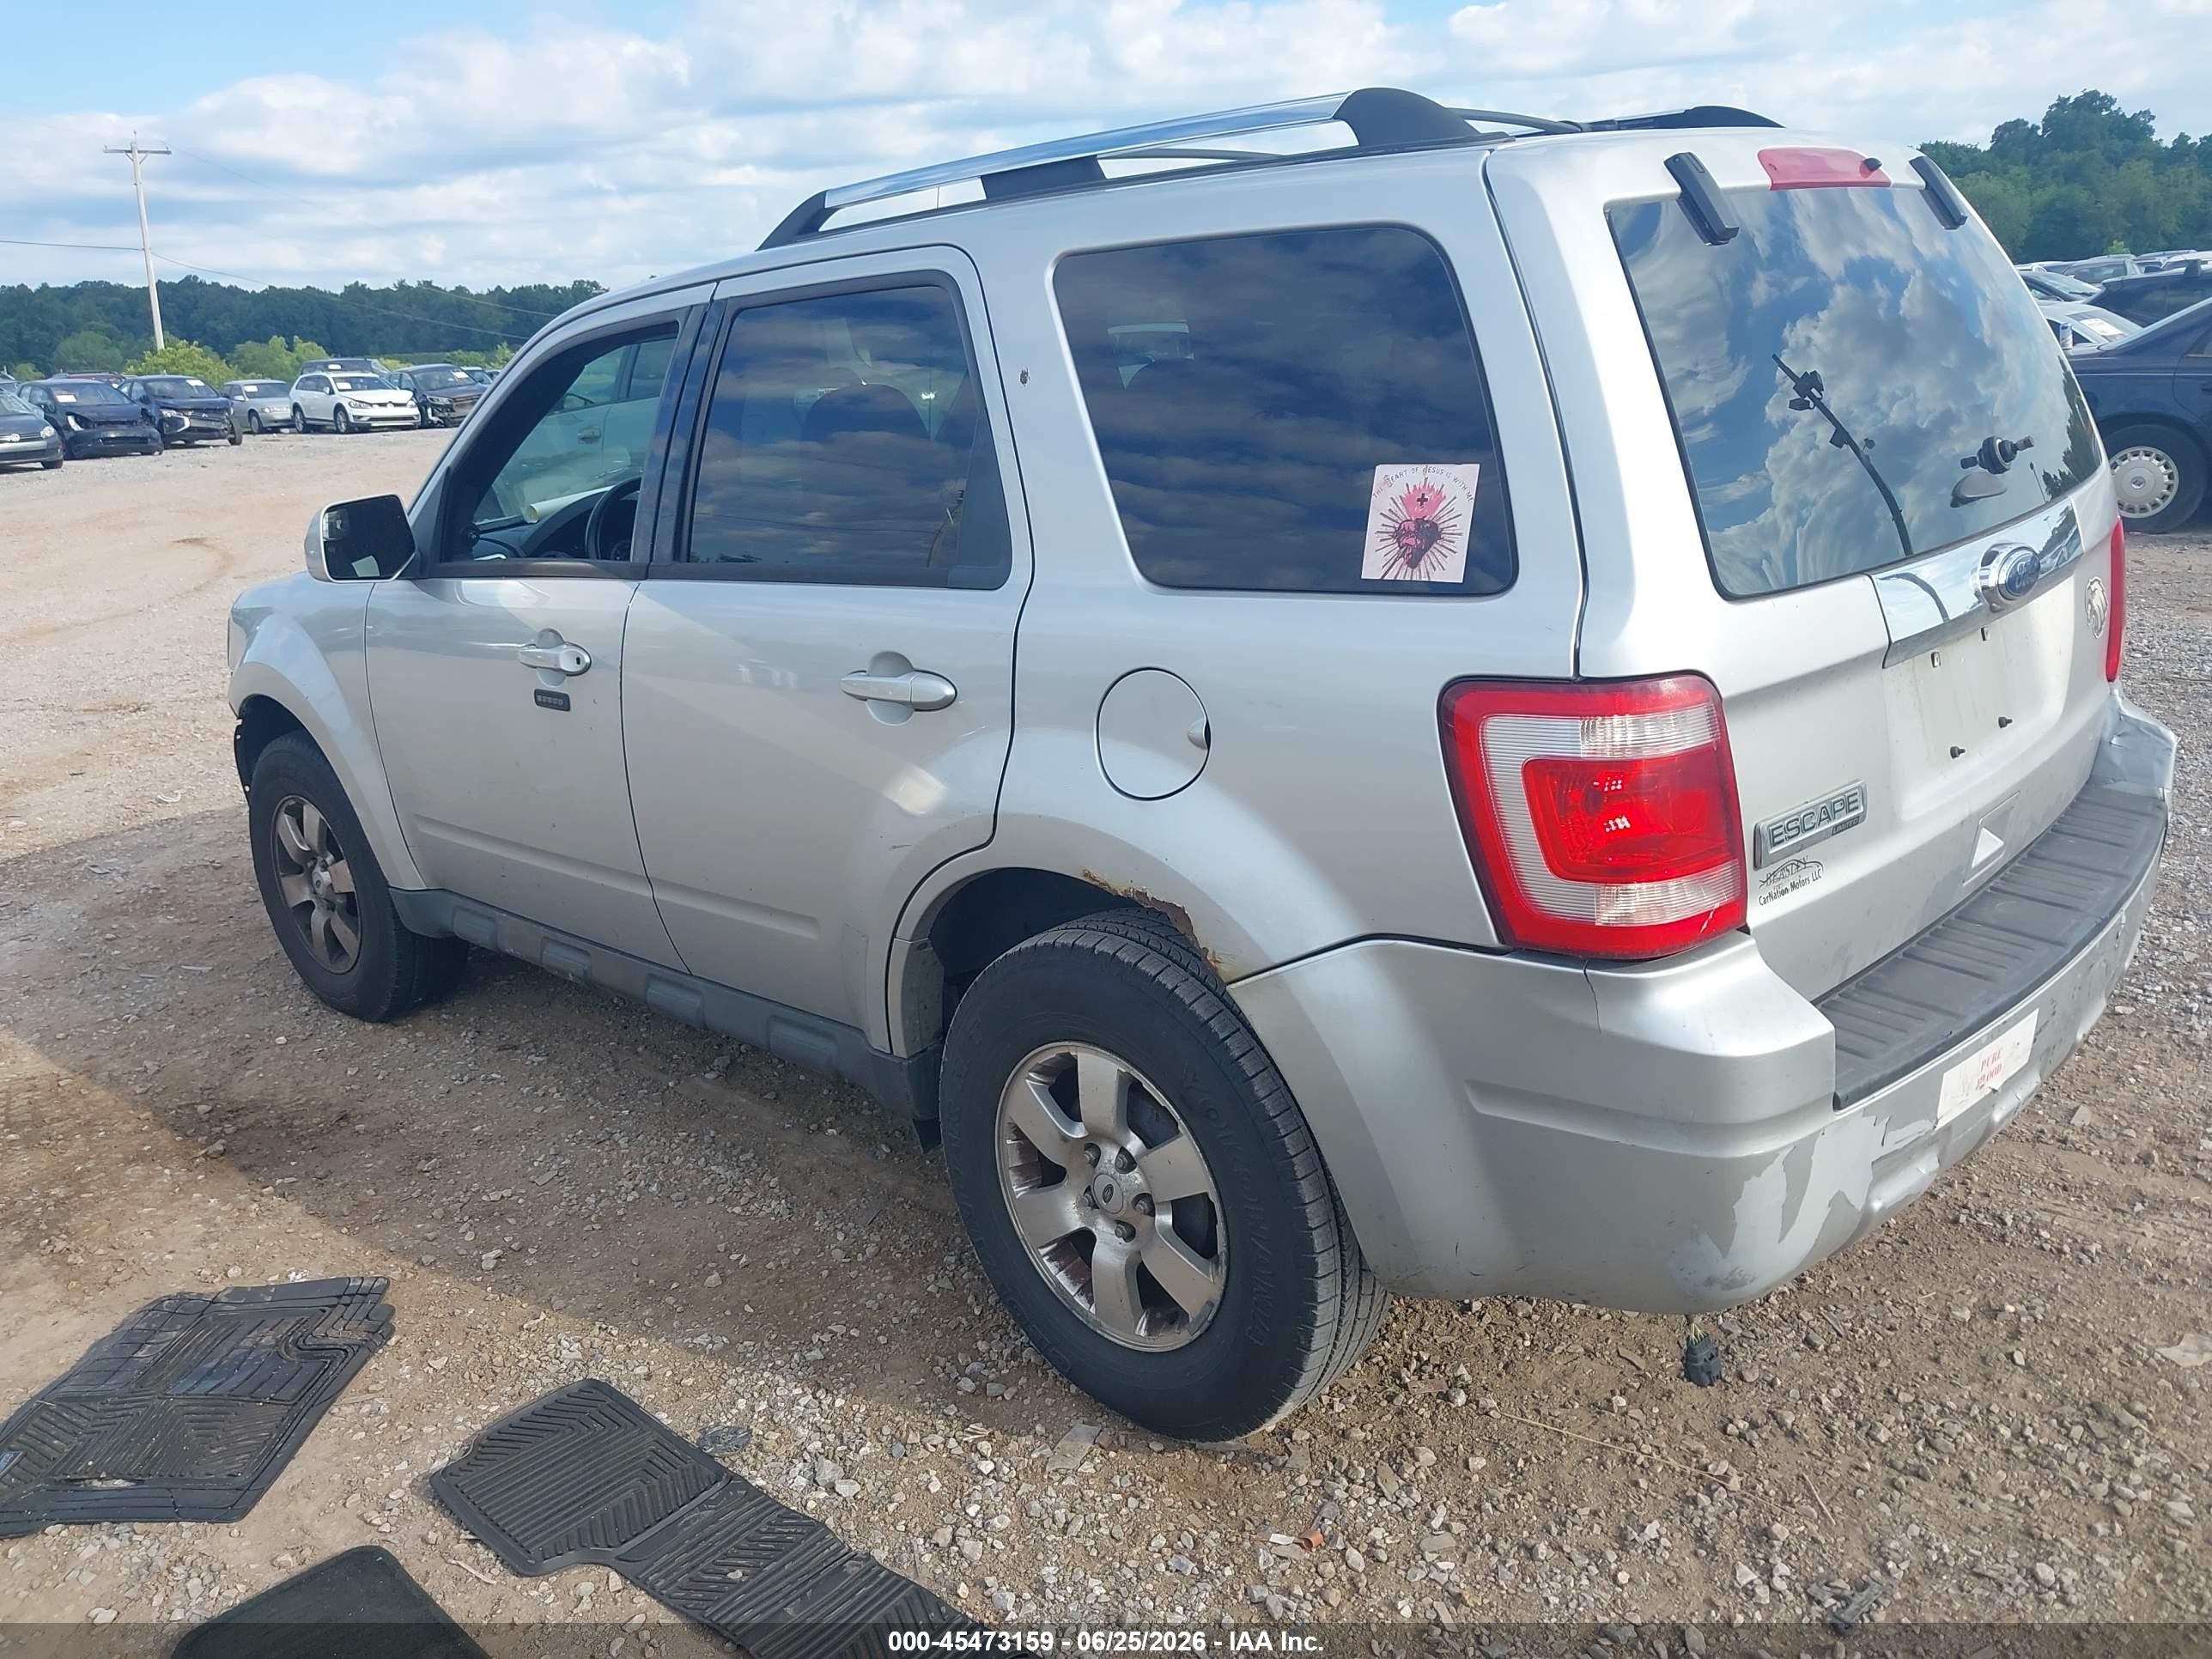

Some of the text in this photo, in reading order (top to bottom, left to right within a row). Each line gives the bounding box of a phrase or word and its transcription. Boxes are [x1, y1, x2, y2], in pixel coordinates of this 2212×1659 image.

[1422, 465, 1444, 477] JESUS
[1453, 476, 1468, 491] WITH
[1770, 791, 1860, 848] ESCAPE
[1759, 886, 1789, 906] CarNation
[1790, 876, 1811, 892] Motors
[1811, 868, 1822, 882] LLC
